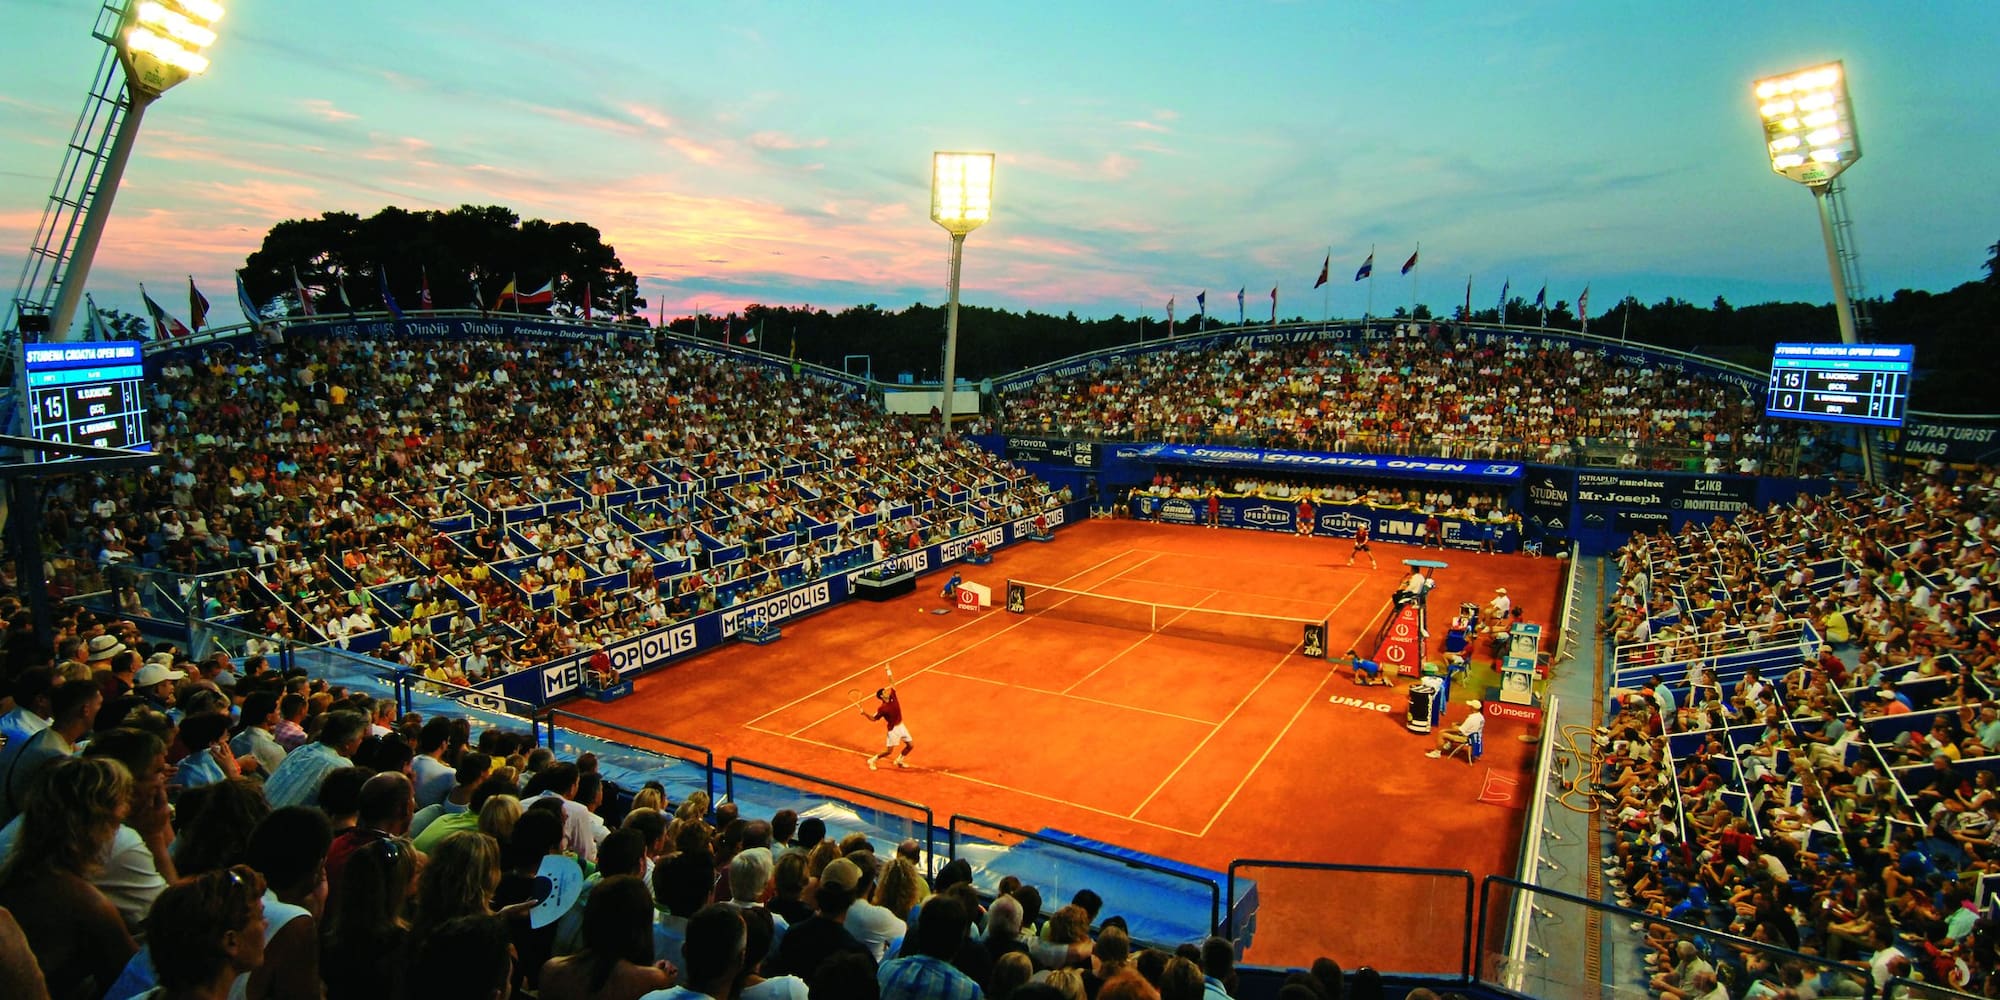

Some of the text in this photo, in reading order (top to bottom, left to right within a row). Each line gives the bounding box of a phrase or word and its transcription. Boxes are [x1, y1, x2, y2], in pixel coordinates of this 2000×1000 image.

[1055, 364, 1087, 377] Allianz
[1002, 379, 1034, 393] Allianz
[1784, 373, 1800, 387] 15
[45, 396, 62, 417] 15
[1783, 394, 1793, 408] 0
[1872, 402, 1880, 411] 2
[1020, 440, 1047, 448] TOYOTA
[1191, 449, 1466, 471] STUDENA CROATIA OPEN
[1705, 480, 1722, 491] IKB
[1530, 485, 1568, 501] STUDENA
[1684, 499, 1748, 512] MONTELEKTRO
[1630, 512, 1668, 520] DIADORA
[1304, 646, 1322, 656] ATP
[546, 629, 692, 692] MEOPOLIS
[1329, 695, 1392, 712] UMAG
